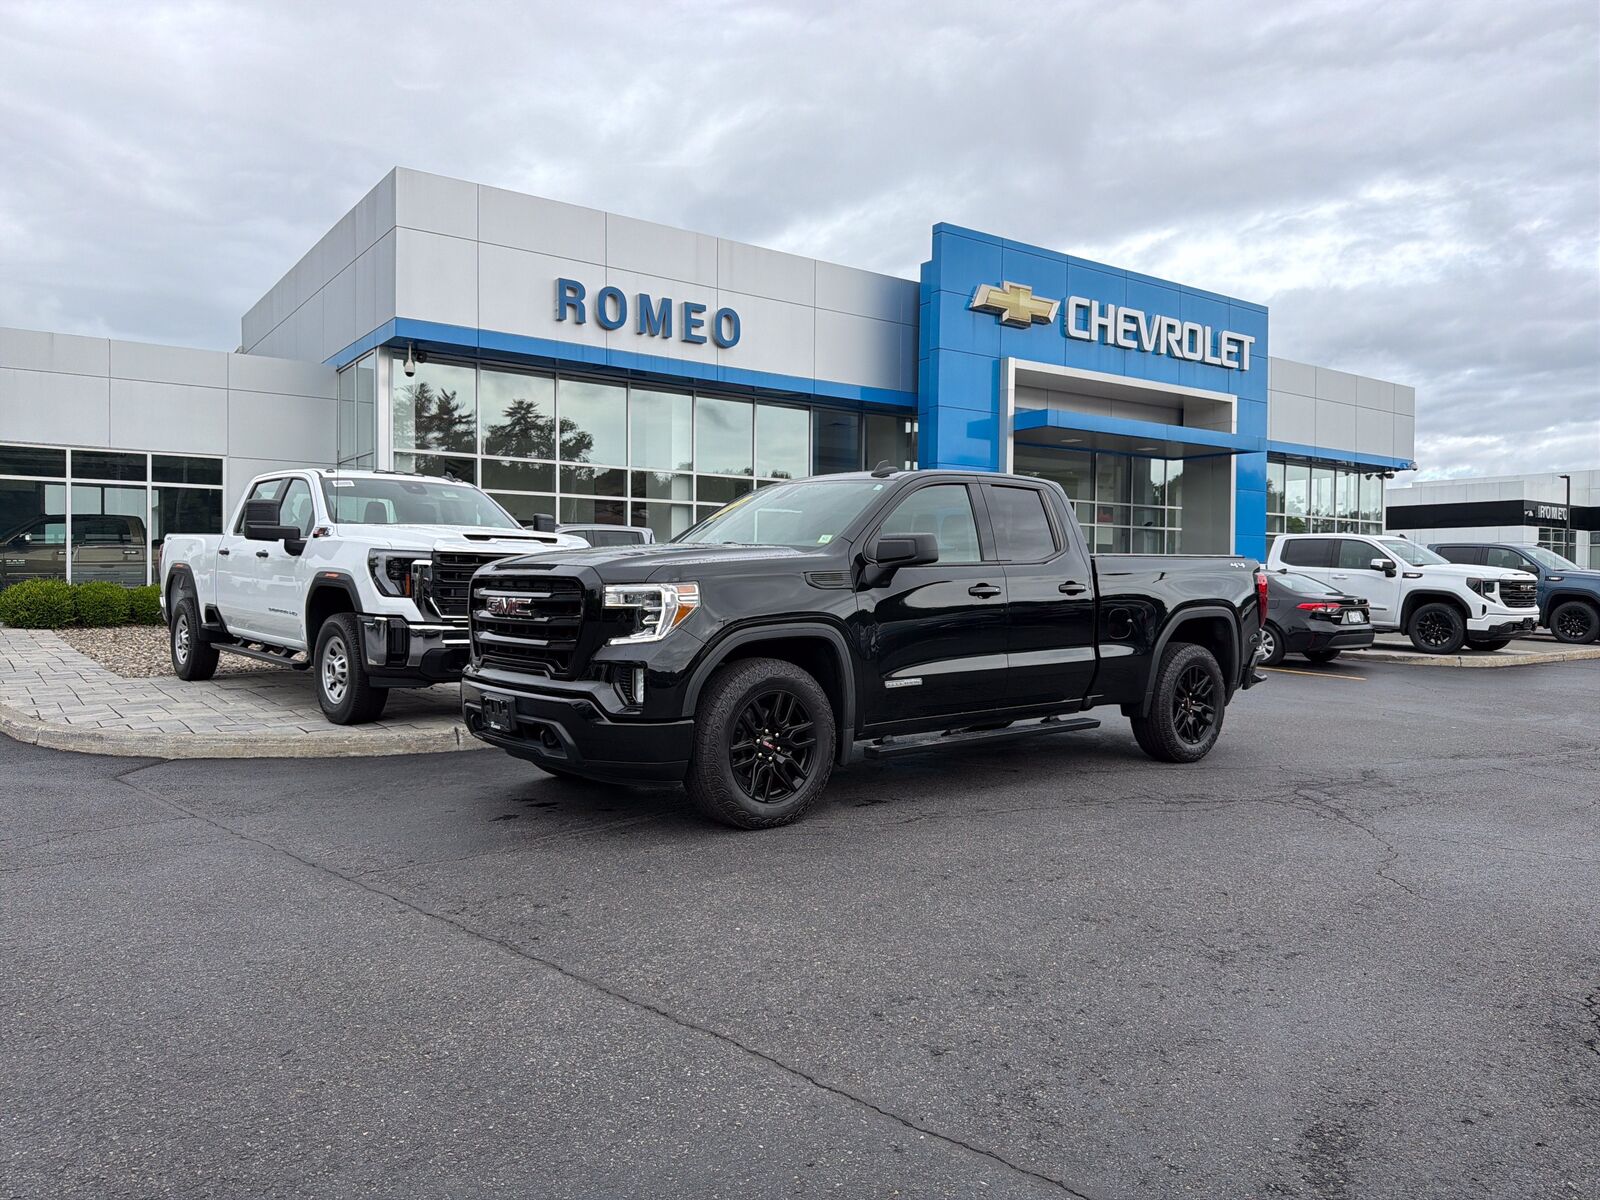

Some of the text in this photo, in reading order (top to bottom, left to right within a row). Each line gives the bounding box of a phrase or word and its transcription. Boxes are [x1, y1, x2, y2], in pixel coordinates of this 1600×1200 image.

[554, 277, 742, 350] ROMEO
[1064, 295, 1256, 371] CHEVROLET
[1538, 505, 1568, 521] ROMEO
[486, 596, 532, 616] GMC
